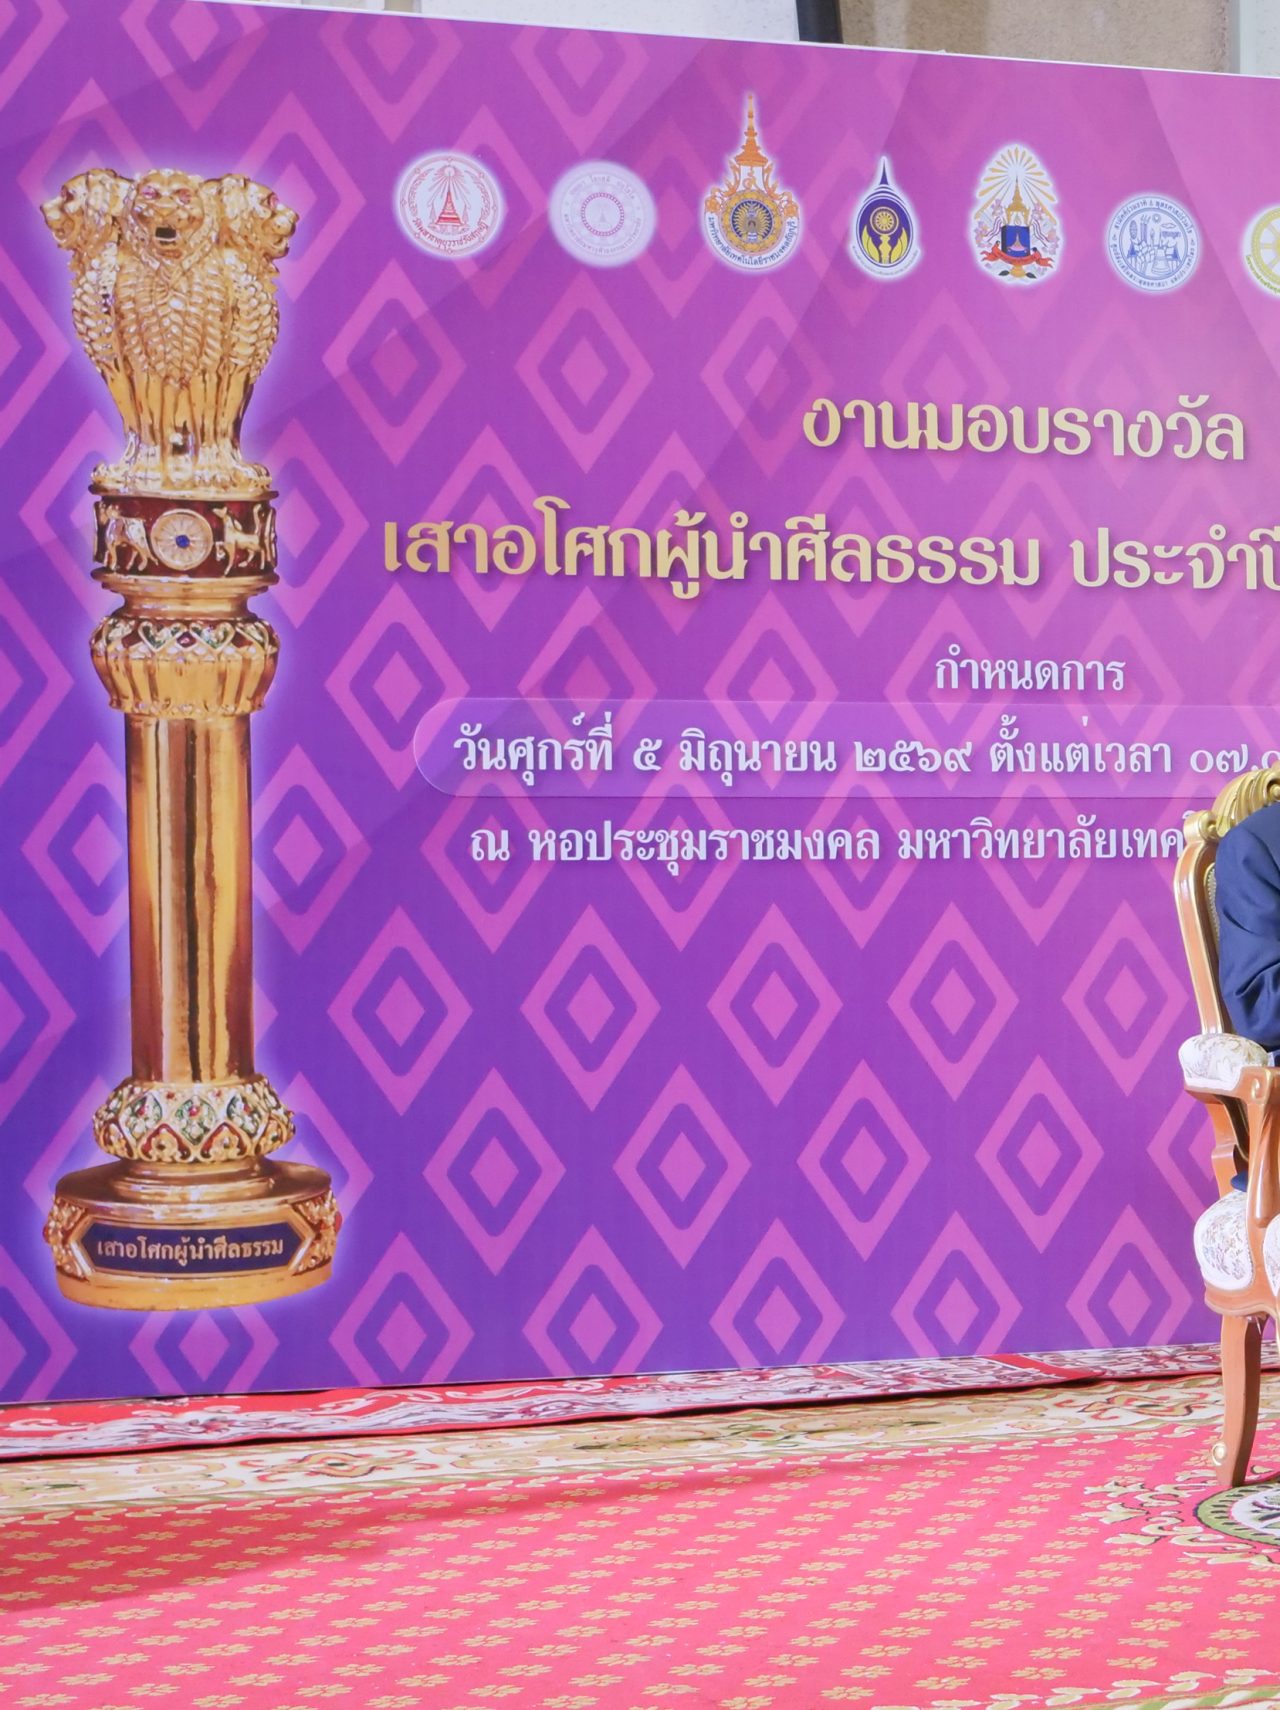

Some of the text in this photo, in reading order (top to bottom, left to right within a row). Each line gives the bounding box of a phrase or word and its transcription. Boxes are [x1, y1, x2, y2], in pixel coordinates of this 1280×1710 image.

[803, 394, 1245, 461] งานมอบรางวัล
[384, 495, 1040, 600] เสาอโศกผู้นำศีลธรรม
[935, 643, 1126, 691] กำหนดการ
[453, 711, 613, 786] วันศุกร์ที่
[633, 737, 663, 771] ๕
[679, 727, 837, 787] มิถุนายน
[854, 739, 972, 772] ๒๕๖๙
[989, 714, 1172, 773] ตั้งแต่เวลา
[470, 829, 510, 861] ณ
[528, 820, 880, 876] หอประชุมราชมงคล
[97, 1234, 285, 1268] เสาอโศกผู้นำศีลธรรม
